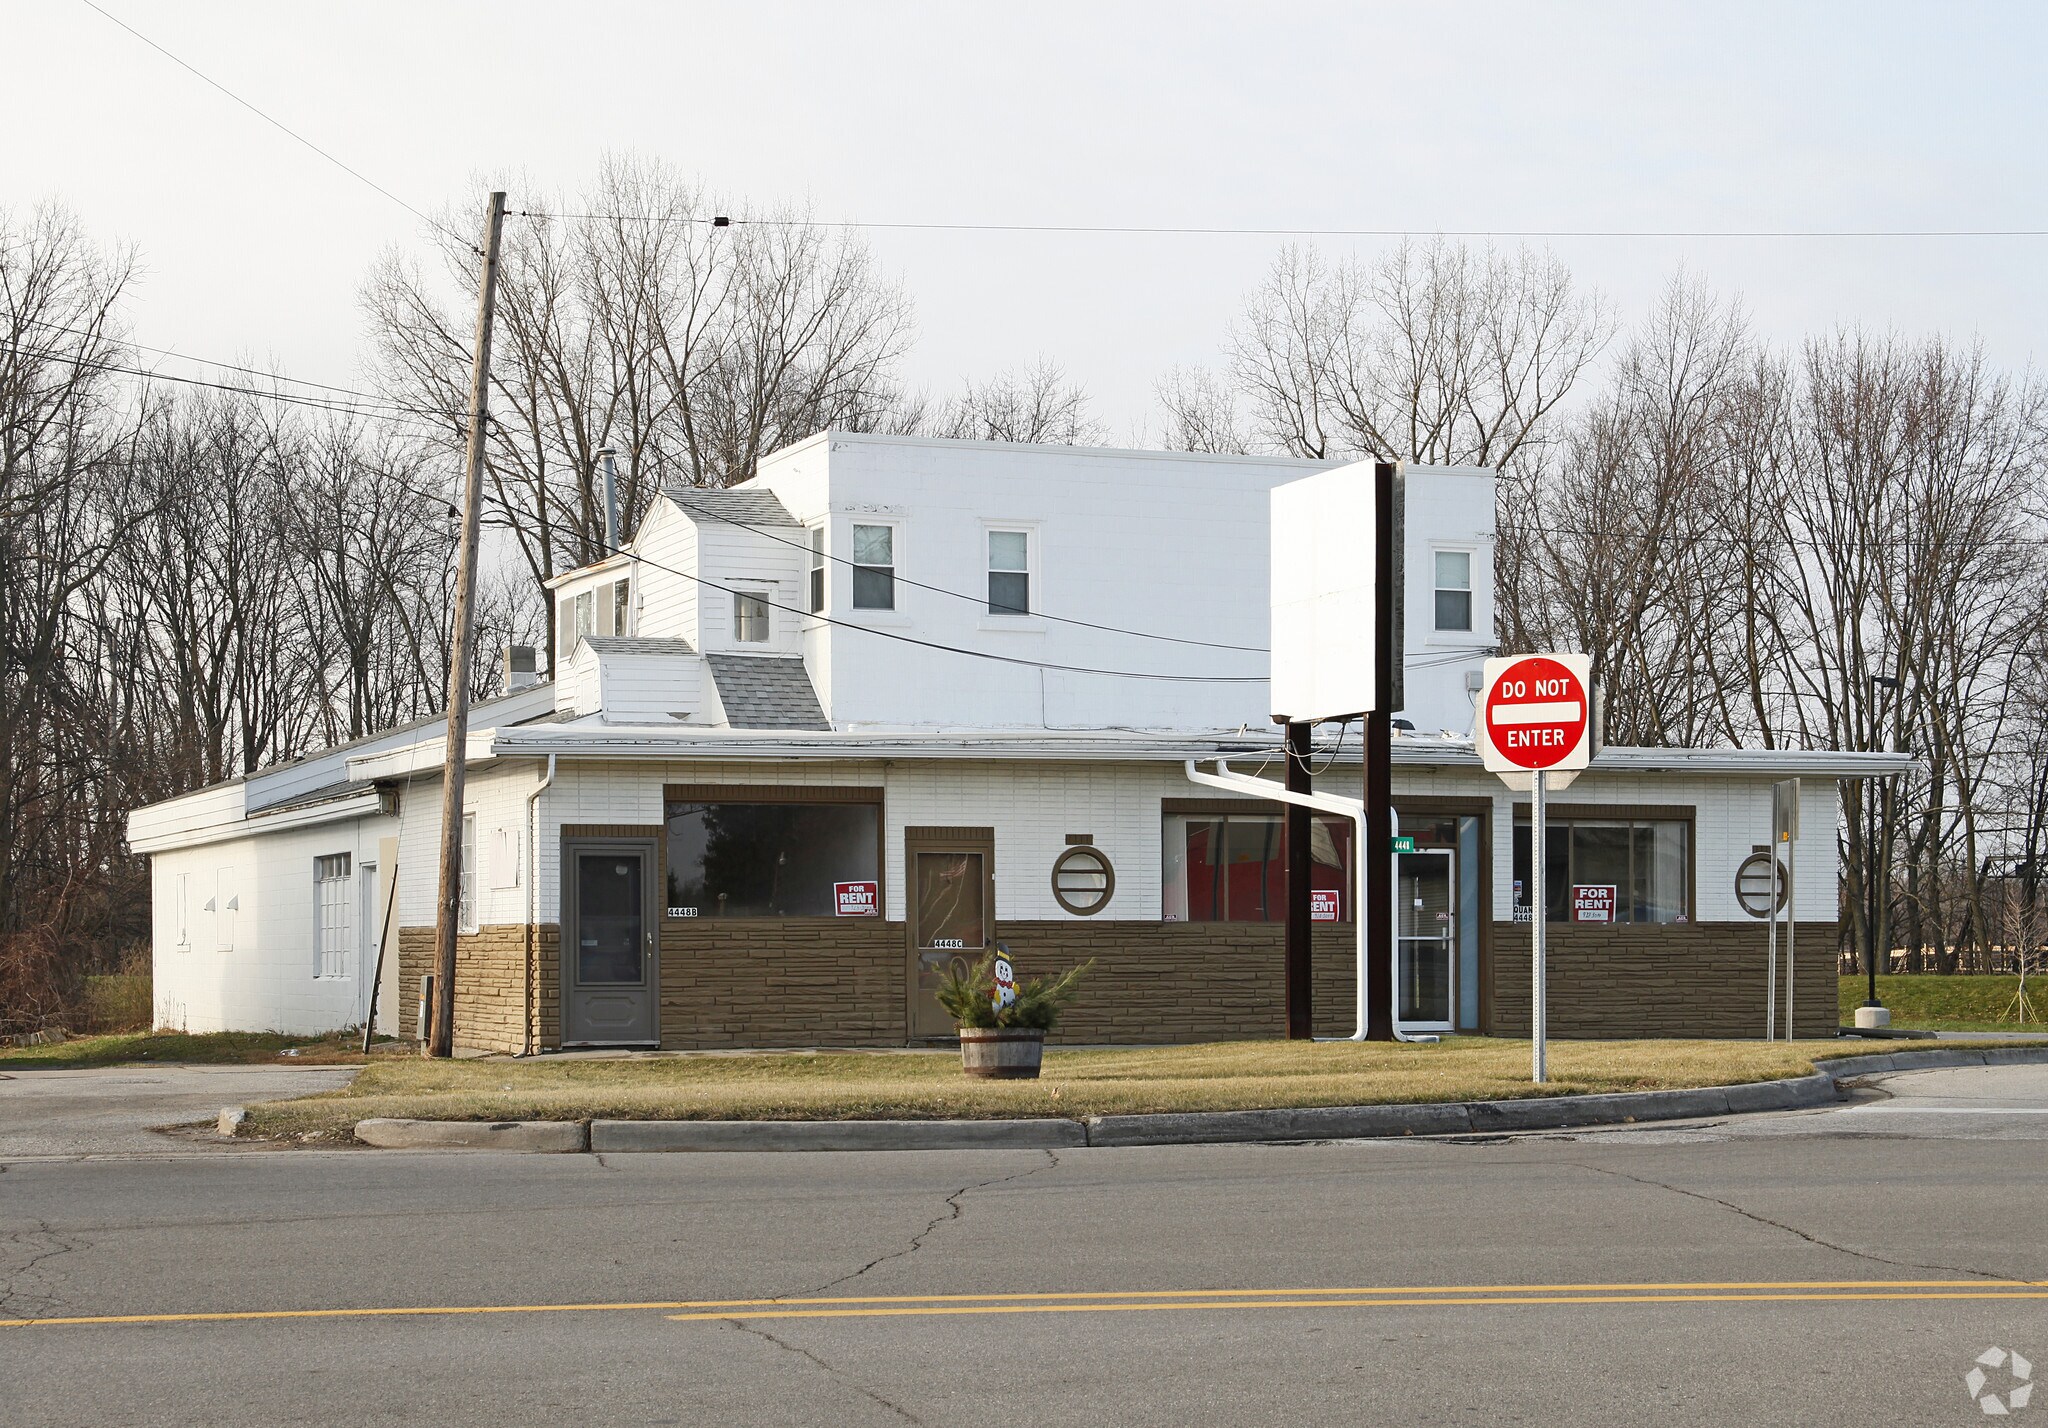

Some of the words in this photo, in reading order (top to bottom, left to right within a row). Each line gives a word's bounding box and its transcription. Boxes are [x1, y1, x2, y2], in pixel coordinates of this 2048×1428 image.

[1502, 680, 1526, 698] DO
[1535, 678, 1570, 697] NOT
[1507, 728, 1565, 748] ENTER
[1395, 841, 1410, 850] 4448
[840, 893, 874, 904] RENT
[1579, 888, 1608, 899] FOR
[1574, 899, 1612, 910] RENT
[668, 908, 697, 916] 4448B
[935, 940, 962, 948] 4448C
